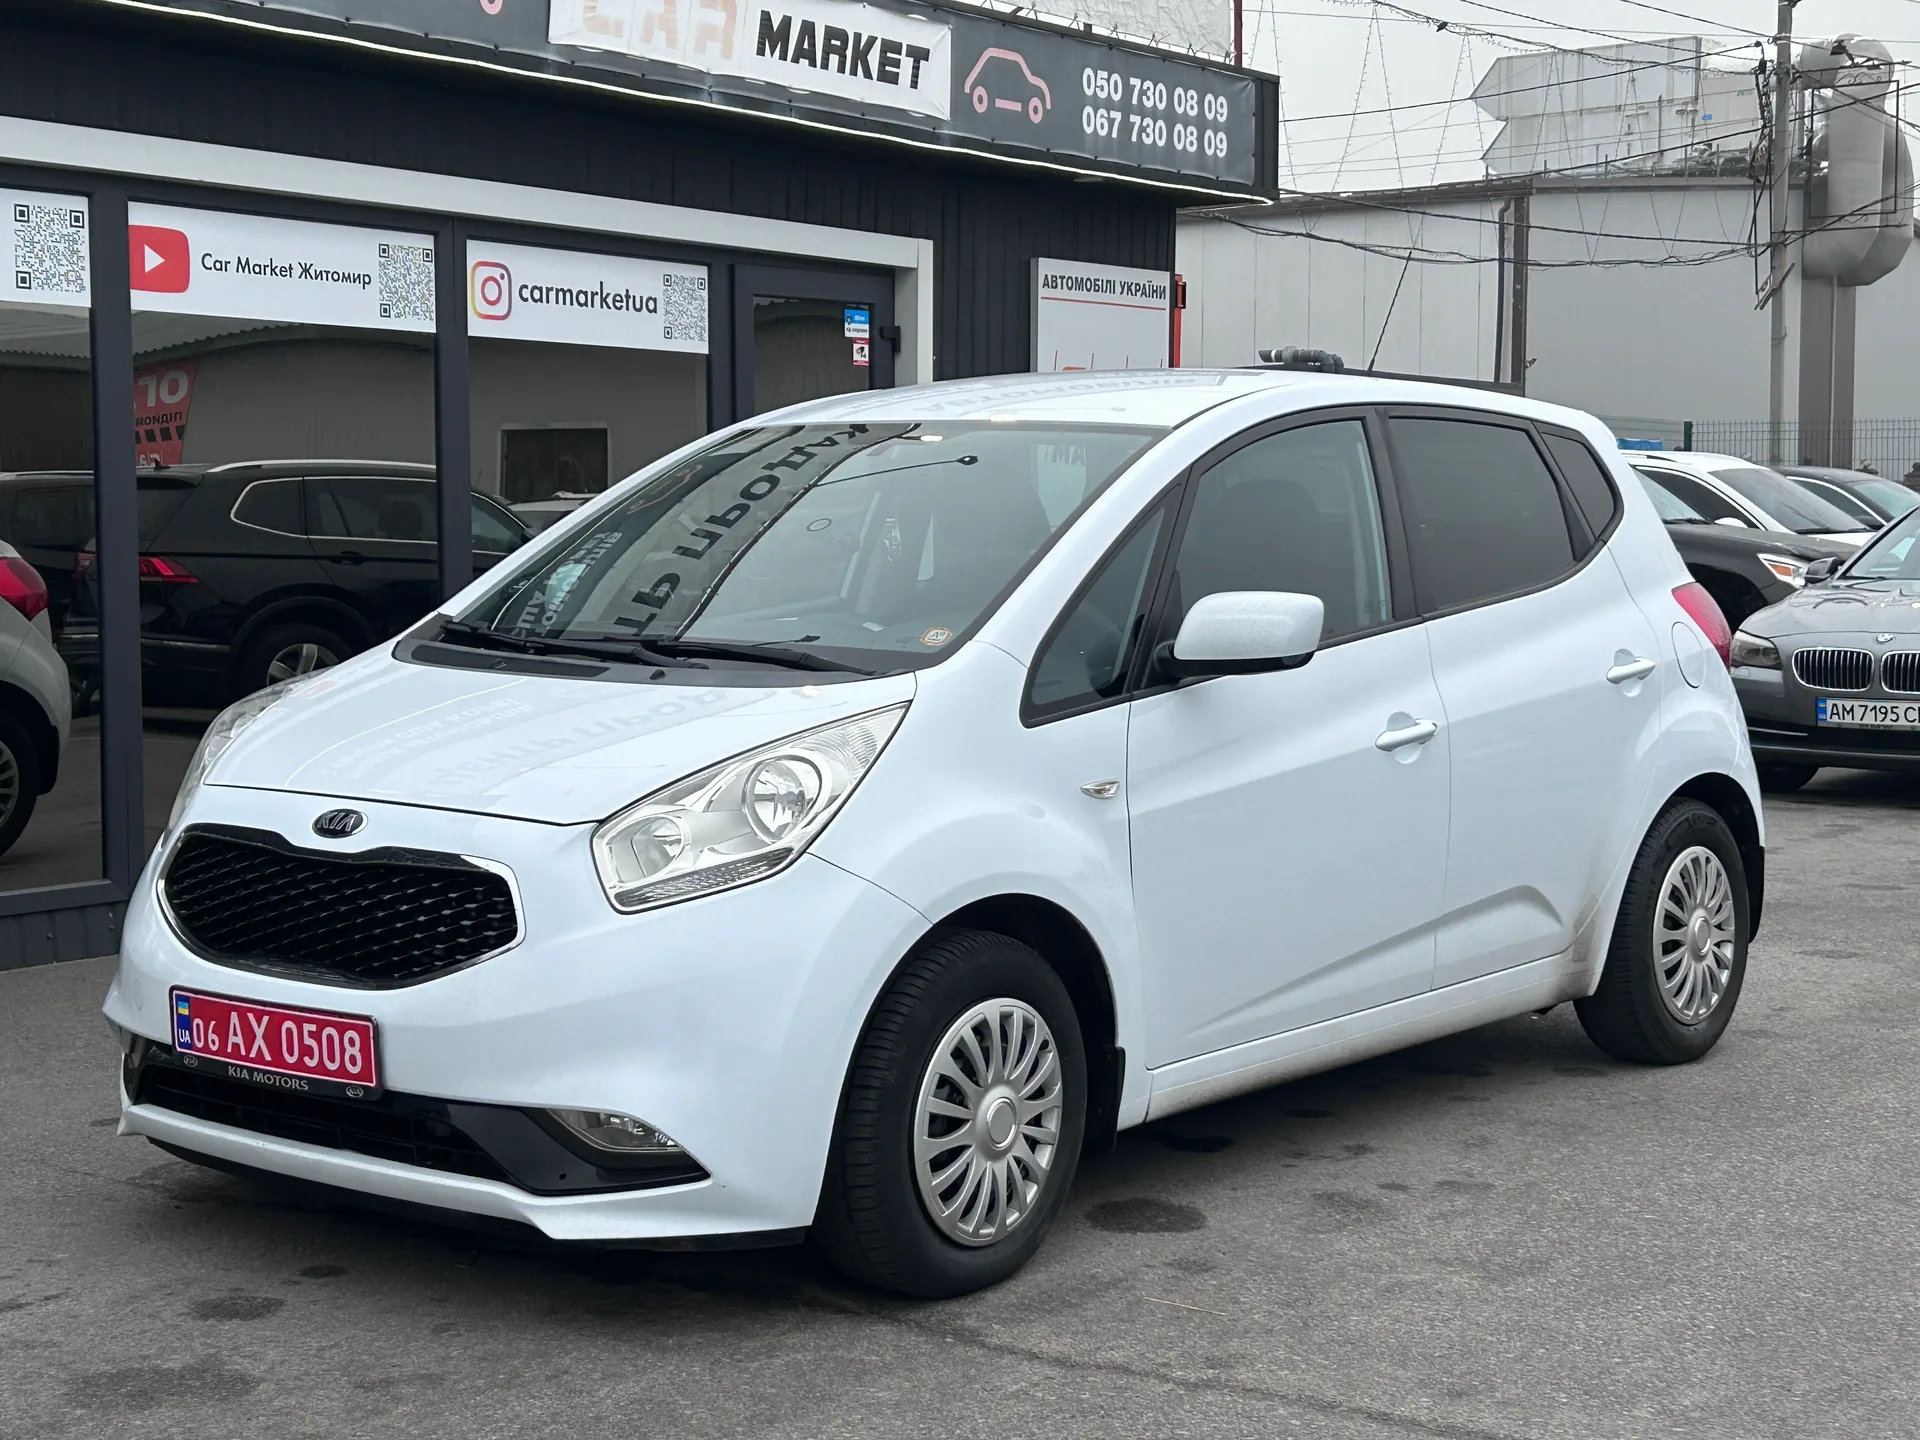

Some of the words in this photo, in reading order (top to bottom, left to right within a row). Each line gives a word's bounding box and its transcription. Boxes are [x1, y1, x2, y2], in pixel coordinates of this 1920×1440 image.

[755, 9, 931, 90] MARKET
[1082, 67, 1123, 101] 050
[1129, 77, 1167, 110] 730
[1173, 87, 1198, 117] 08
[1203, 93, 1228, 123] 09
[1082, 105, 1122, 138] 067
[1129, 114, 1167, 147] 730
[1173, 123, 1198, 152] 08
[1203, 129, 1228, 158] 09
[201, 252, 231, 272] Car
[235, 256, 294, 279] Market
[298, 261, 372, 289] Житомир
[1042, 273, 1116, 295] АВТОМОБІЛІ
[1119, 280, 1166, 300] УКРАЇНИ
[518, 281, 658, 314] carmarketua
[1829, 703, 1855, 720] AM
[1858, 704, 1900, 723] 7195
[1904, 706, 1920, 723] C
[317, 811, 358, 832] KIA
[178, 1028, 191, 1044] UA
[192, 1017, 220, 1051] 06
[226, 1011, 272, 1061] AX
[281, 1020, 362, 1074] 0508
[228, 1065, 249, 1080] KIA
[253, 1072, 308, 1091] MOTORS
